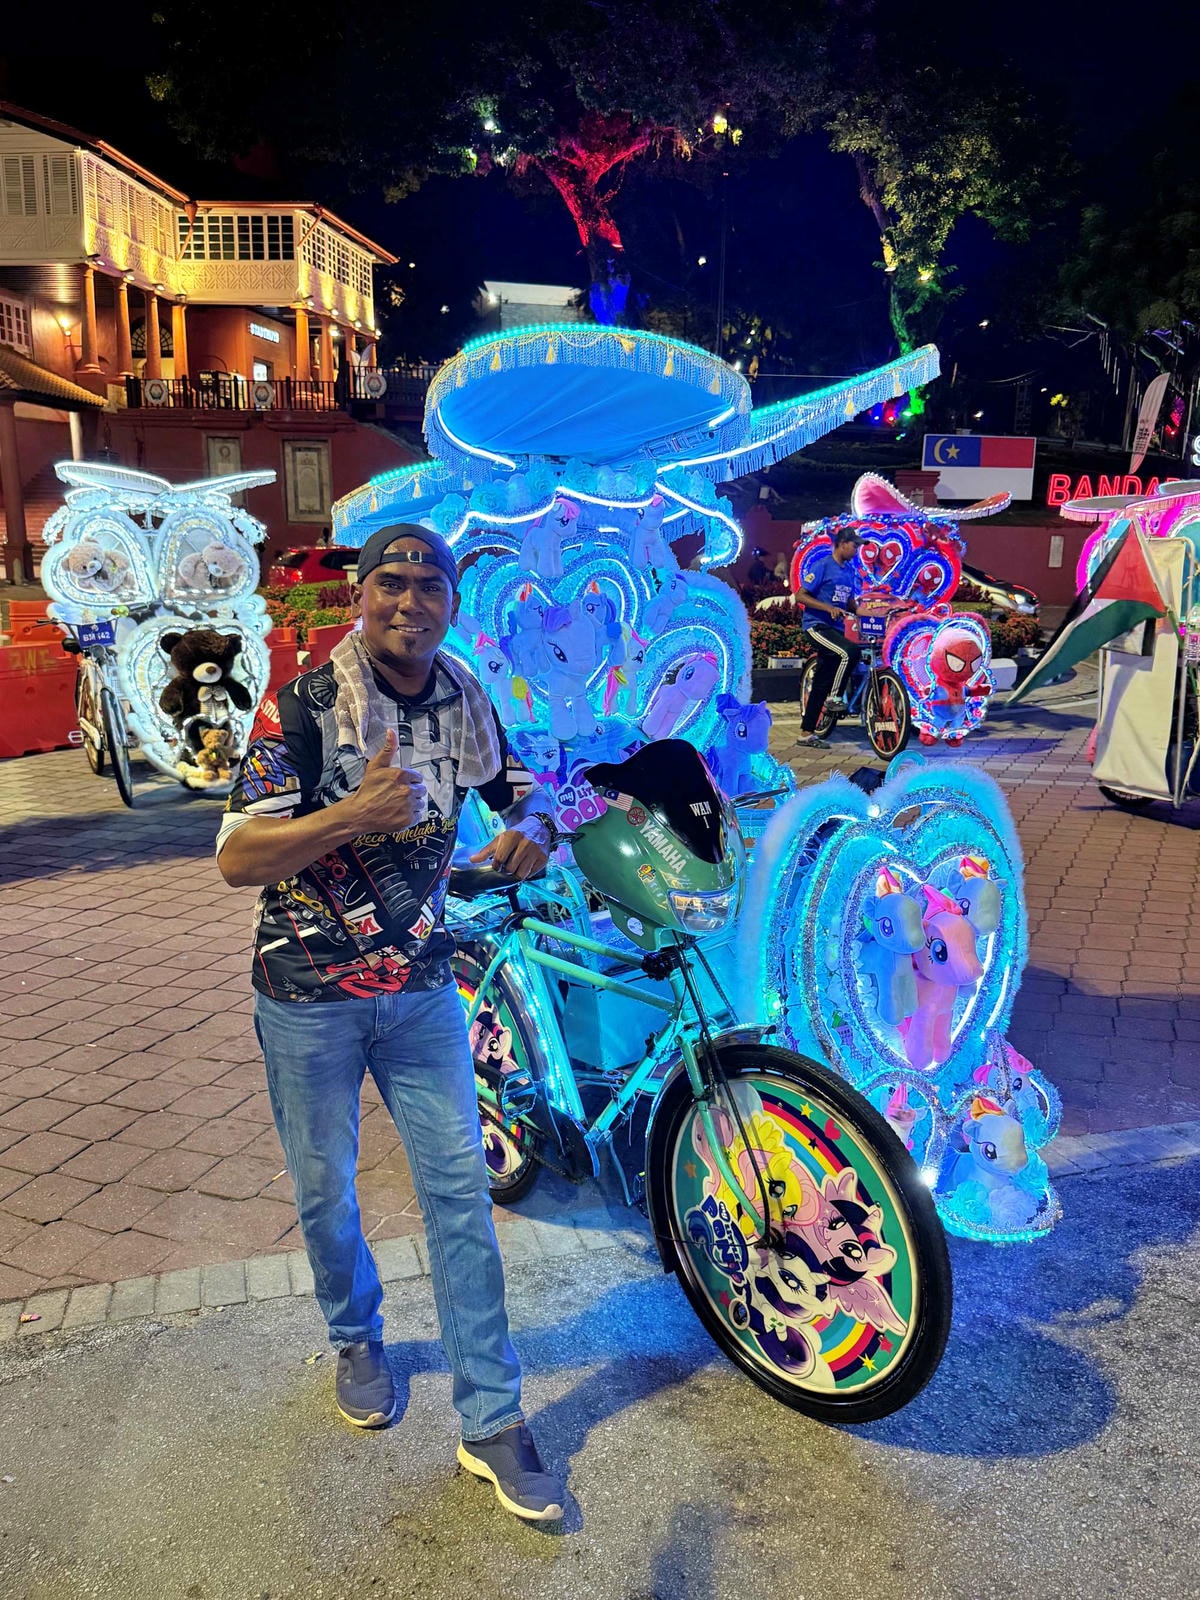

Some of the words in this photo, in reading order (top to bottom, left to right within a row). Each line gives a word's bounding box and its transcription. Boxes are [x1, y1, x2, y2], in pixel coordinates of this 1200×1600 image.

[1048, 473, 1181, 507] BANDA
[83, 632, 96, 642] BM
[559, 791, 574, 803] my
[689, 801, 712, 817] WAN
[639, 819, 687, 874] YAMAHA
